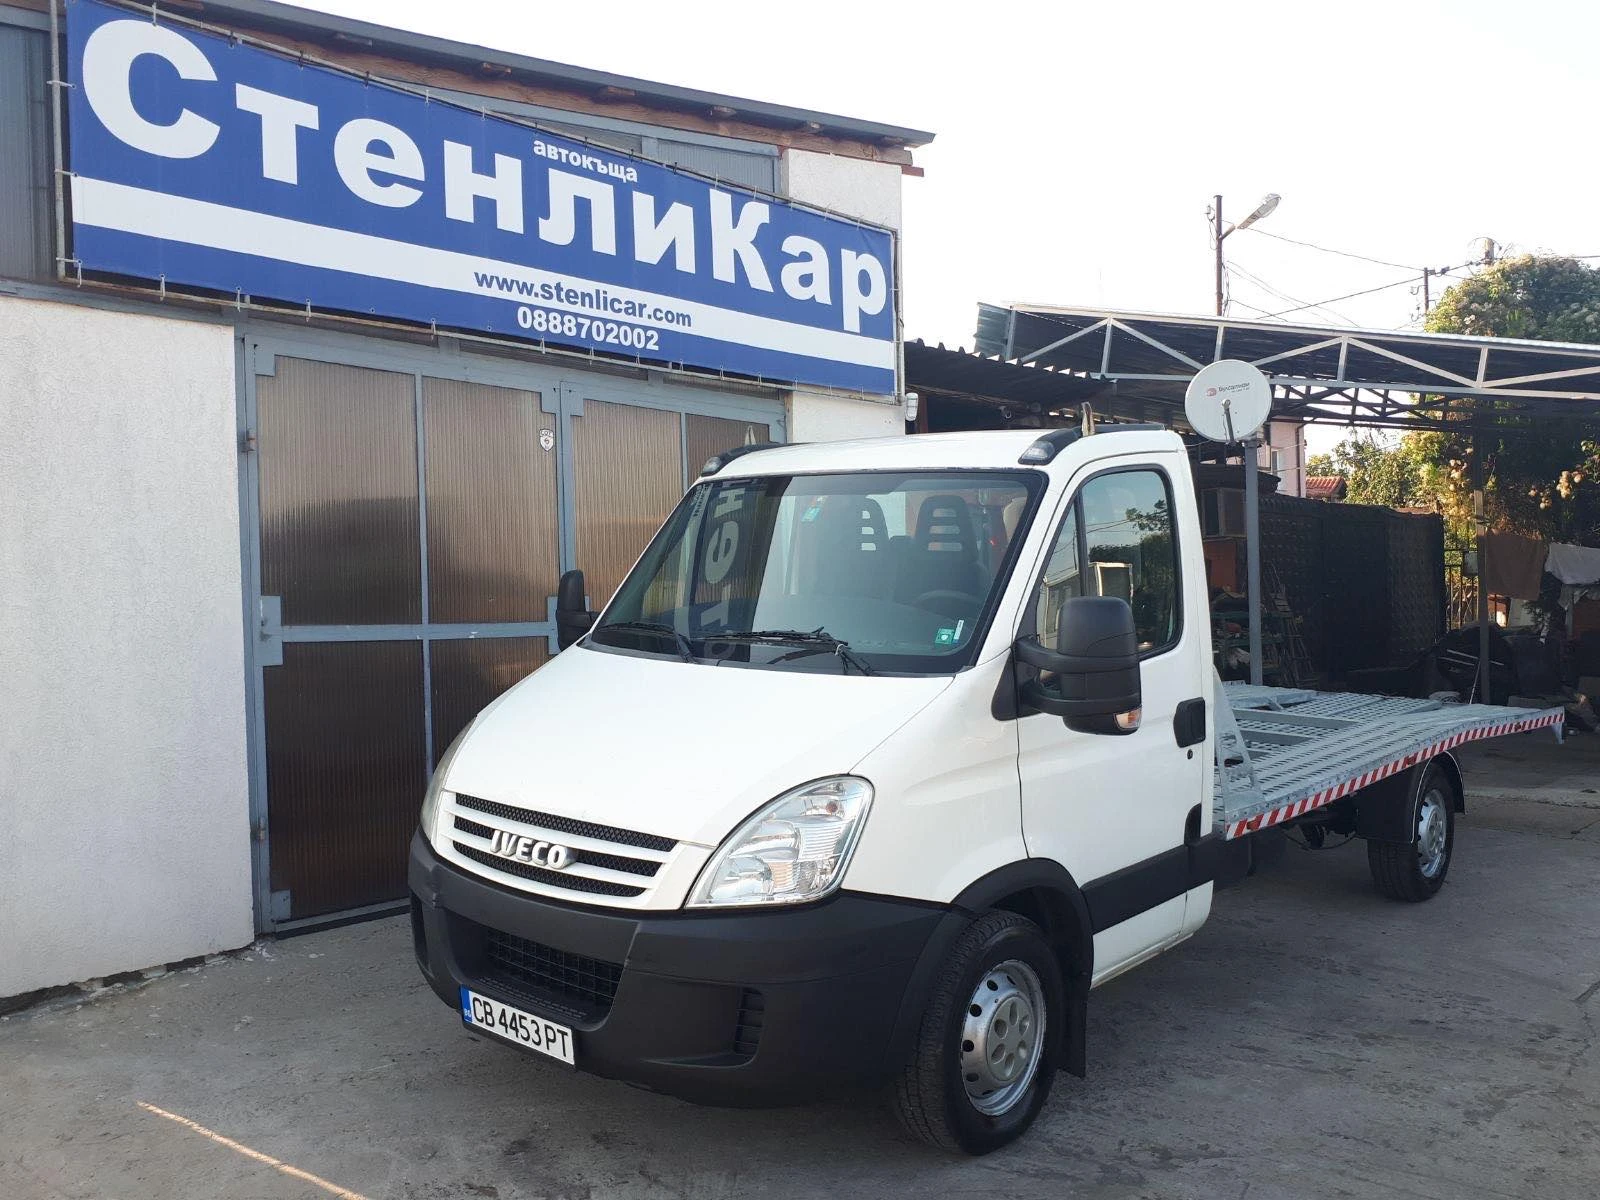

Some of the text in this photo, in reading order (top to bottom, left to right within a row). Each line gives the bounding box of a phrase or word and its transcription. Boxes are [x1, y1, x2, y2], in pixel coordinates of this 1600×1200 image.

[82, 19, 887, 333] СтенлиКар
[533, 140, 638, 183] автокъща
[474, 272, 692, 327] www.stenlicar.com
[517, 306, 659, 350] 0888702002
[490, 829, 569, 870] IVECO
[499, 1008, 542, 1046] 4453
